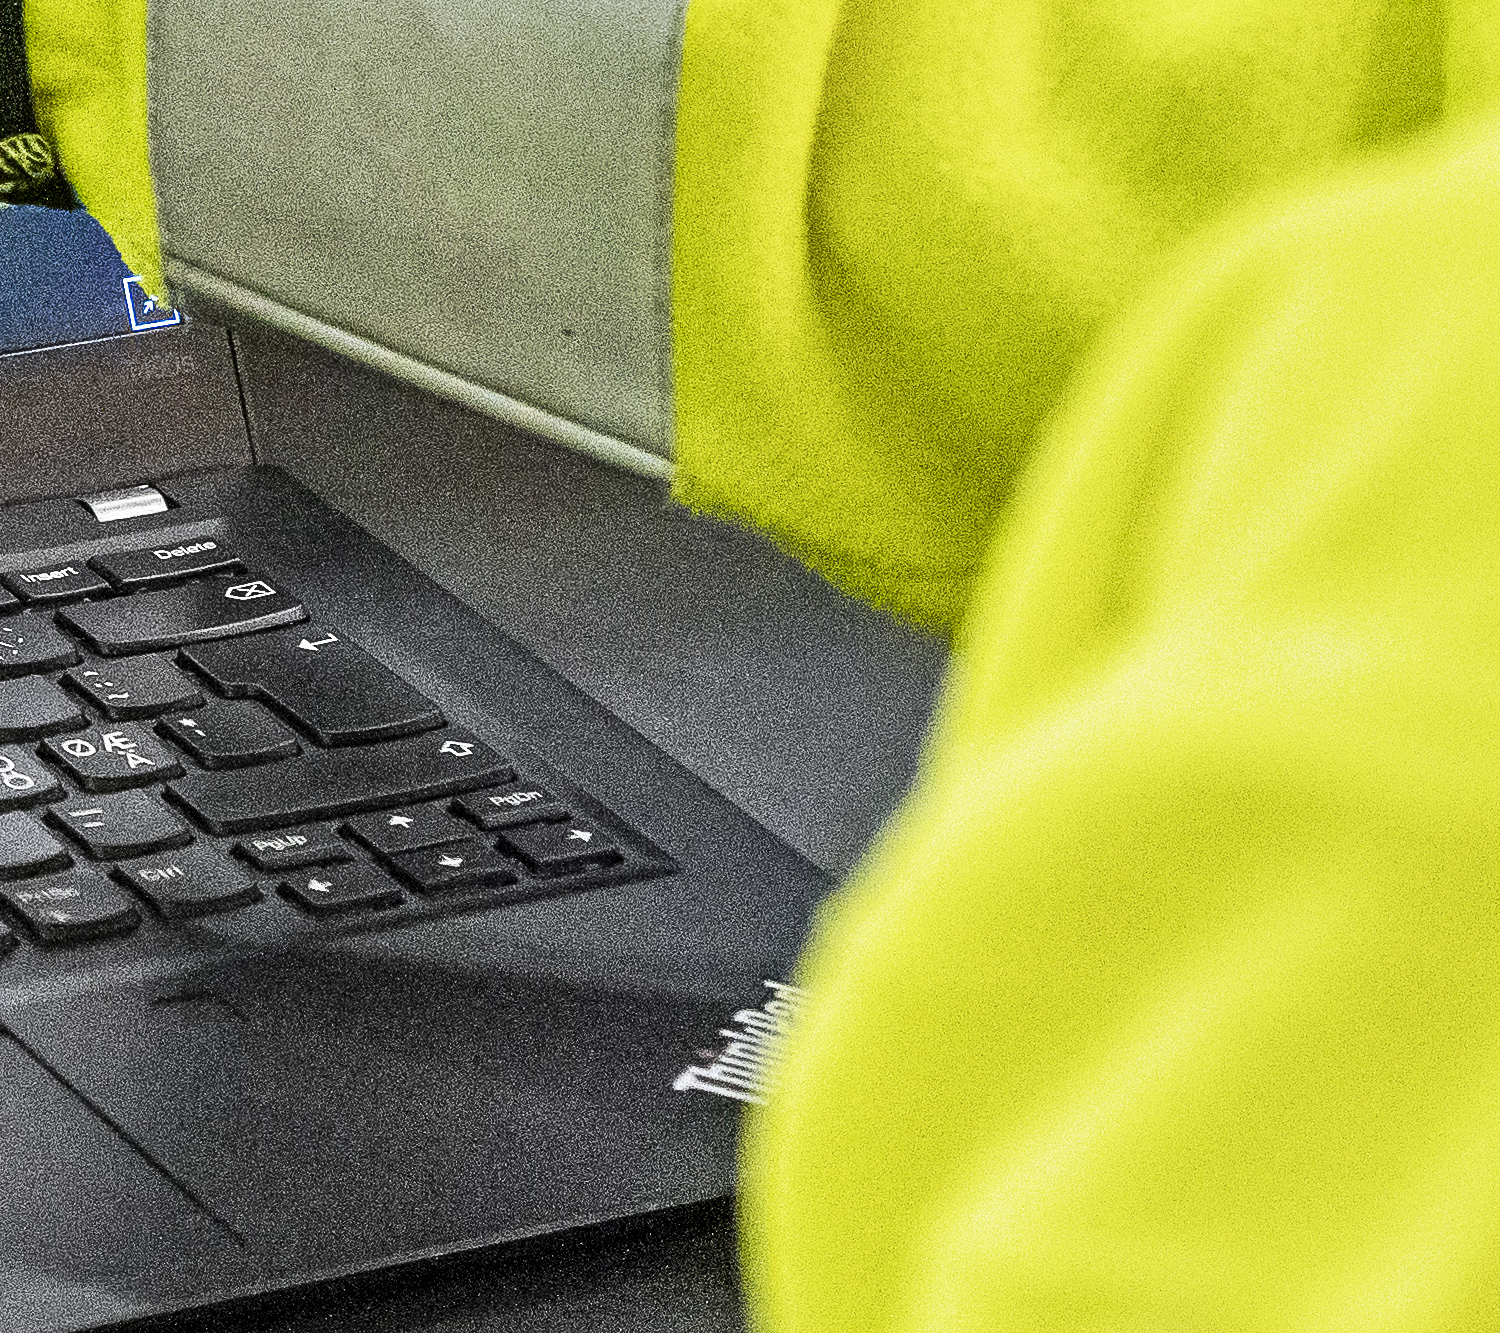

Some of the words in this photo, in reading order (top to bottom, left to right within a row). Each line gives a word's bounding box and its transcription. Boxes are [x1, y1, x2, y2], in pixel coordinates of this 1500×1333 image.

[153, 539, 217, 561] Delete
[19, 566, 79, 583] Insert
[251, 833, 309, 853] PgUp
